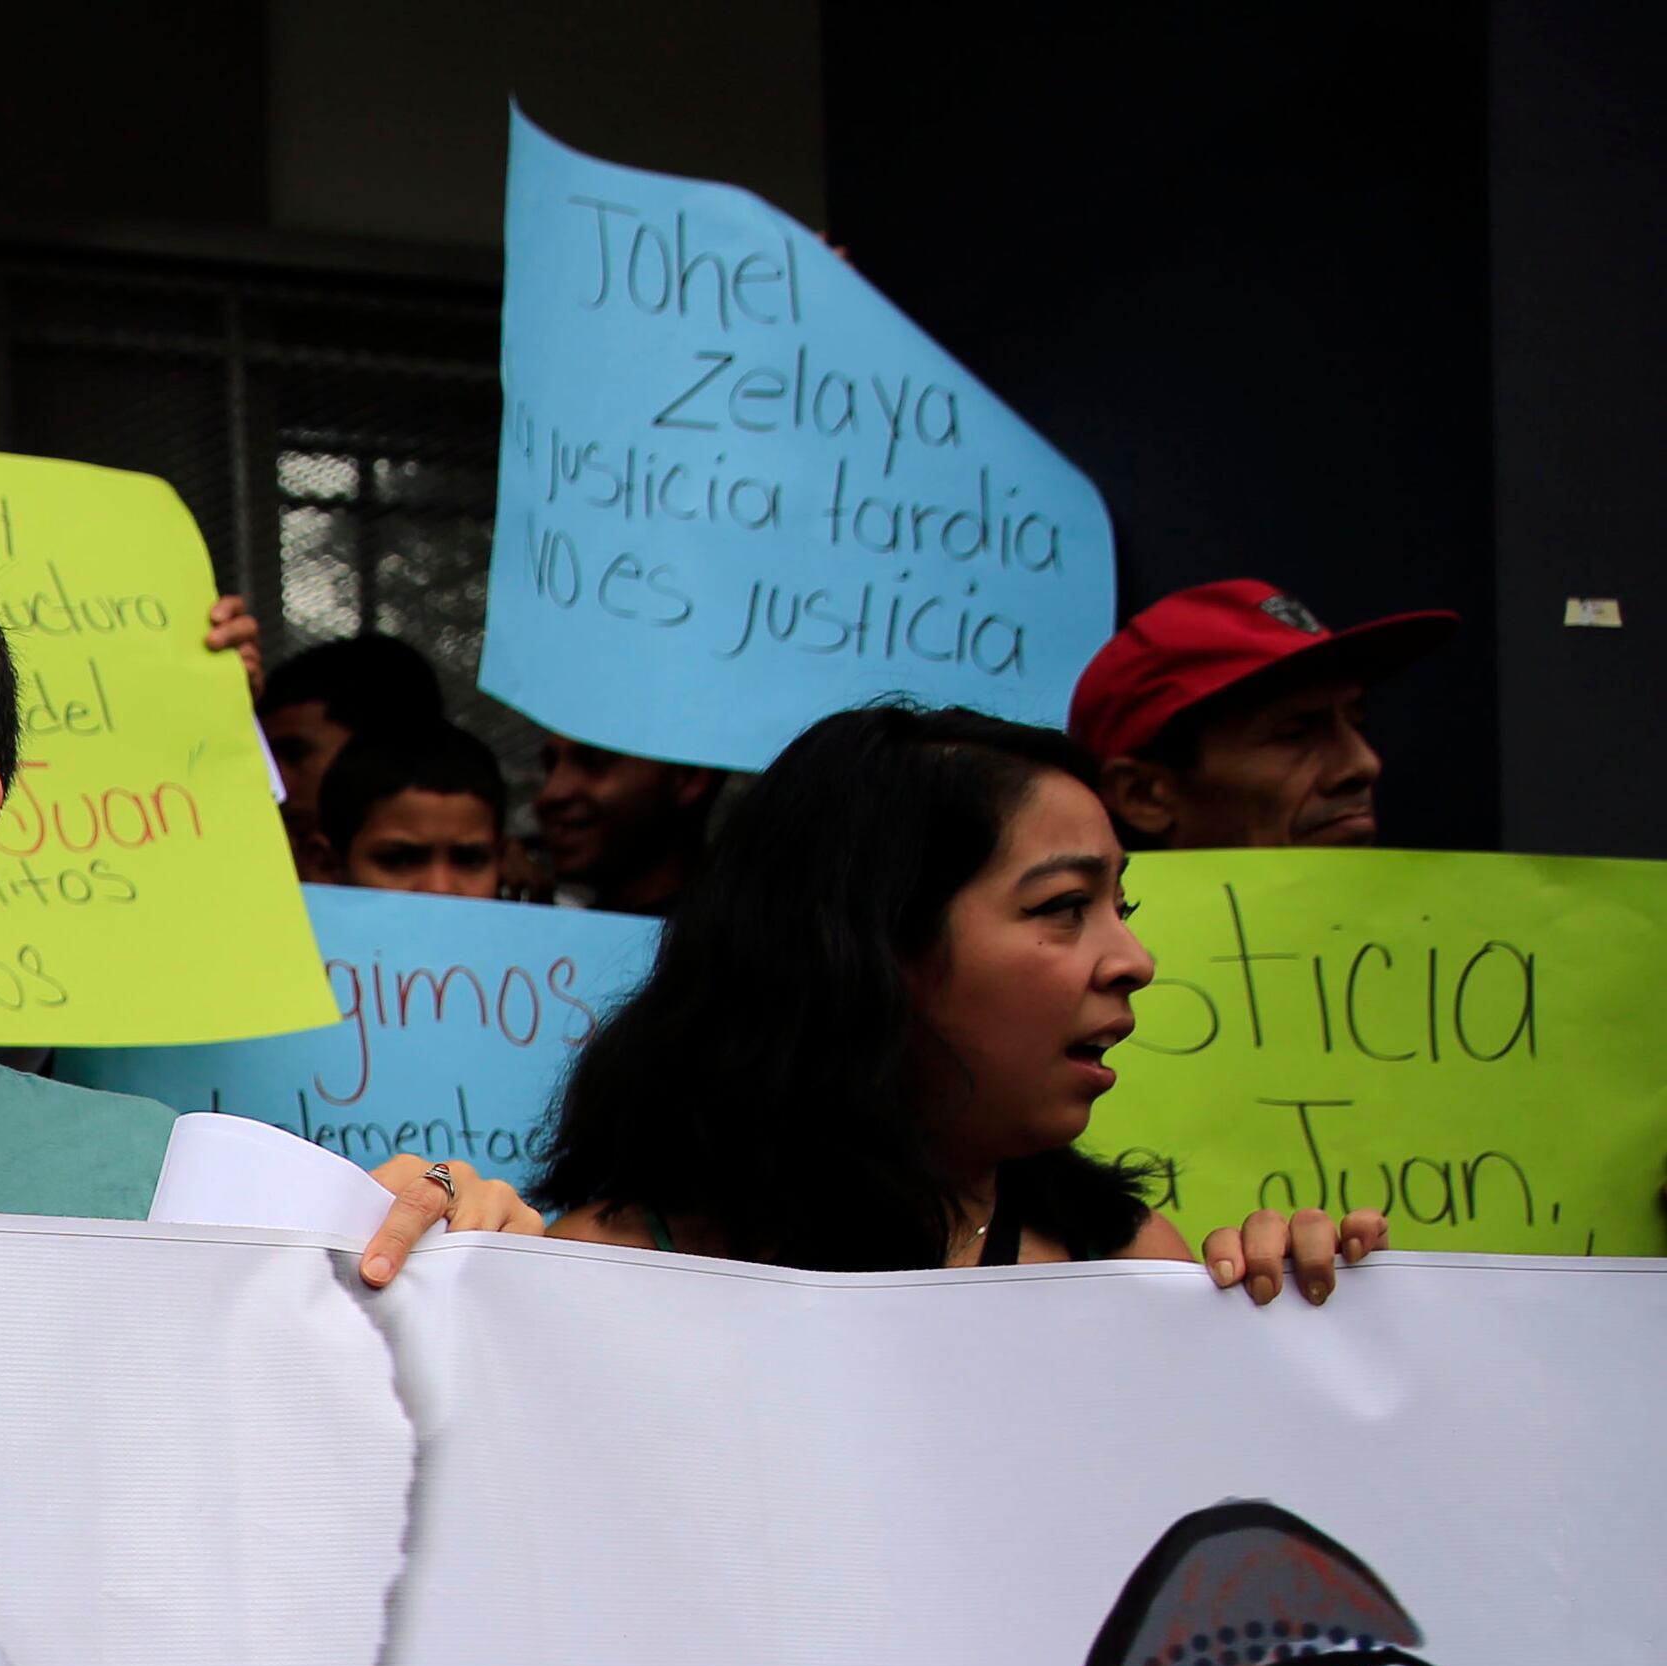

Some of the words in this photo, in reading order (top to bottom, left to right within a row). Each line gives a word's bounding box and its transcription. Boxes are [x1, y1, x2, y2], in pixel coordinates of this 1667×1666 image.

[651, 345, 961, 478] Zelaya
[597, 550, 696, 629] es
[313, 948, 601, 1108] gimos
